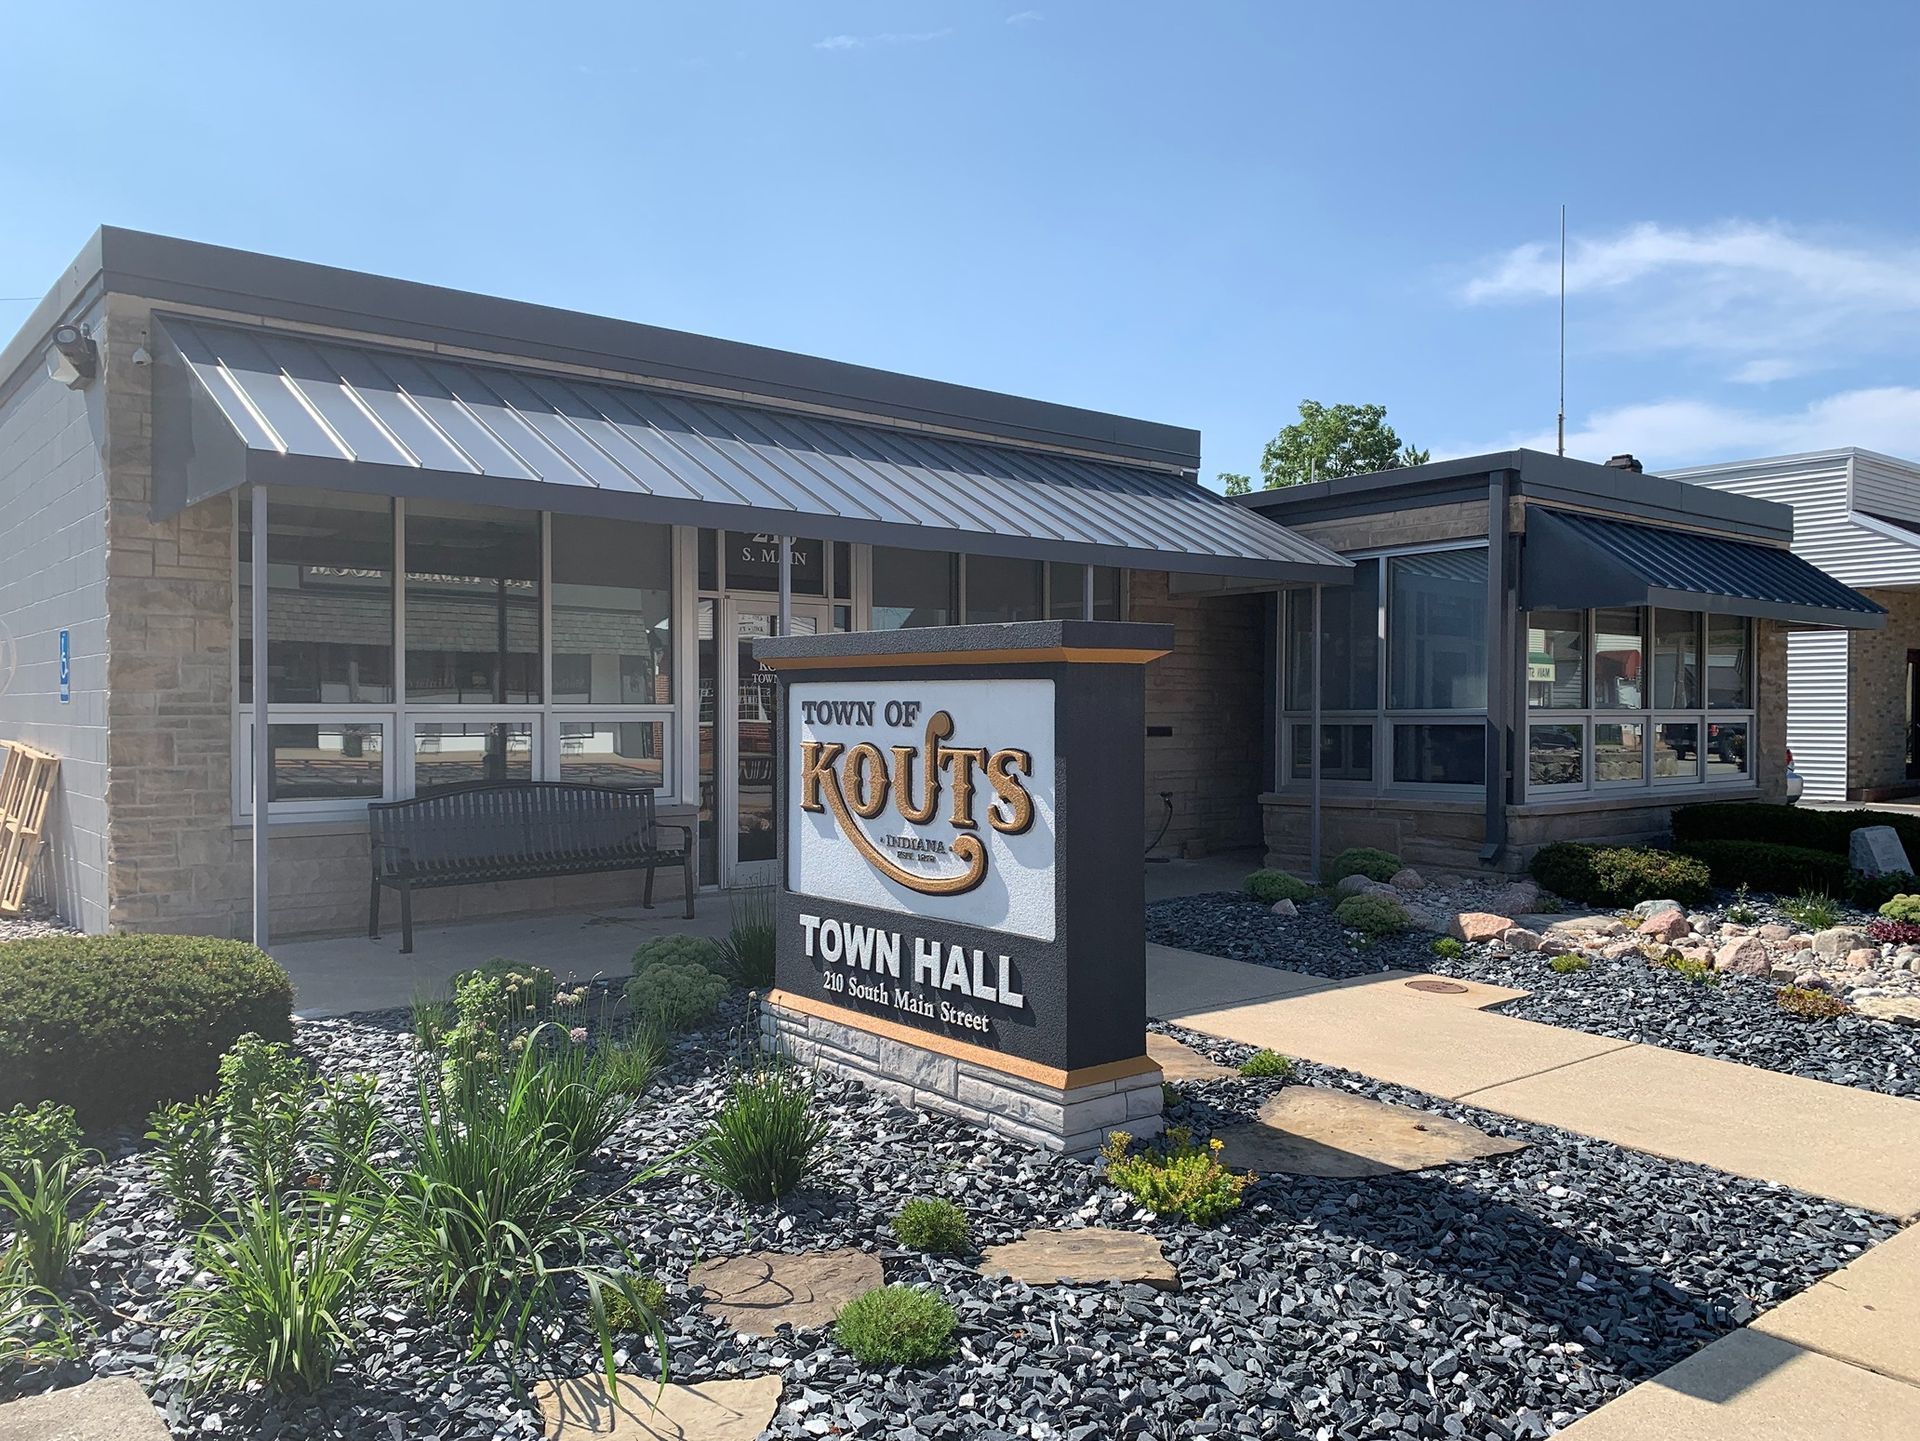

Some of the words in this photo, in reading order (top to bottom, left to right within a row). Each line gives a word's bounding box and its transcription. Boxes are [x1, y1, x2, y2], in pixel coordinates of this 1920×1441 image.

[742, 547, 755, 562] S.
[761, 549, 807, 566] MN
[801, 700, 875, 727] TOWN
[884, 700, 921, 728] OF
[800, 710, 1035, 836] KOUTS
[885, 834, 948, 855] INDIANA
[800, 914, 901, 979] TOWN
[914, 937, 1024, 1009] HALL
[823, 970, 845, 993] 210
[848, 976, 889, 1006] South
[893, 987, 935, 1019] Main
[940, 1000, 990, 1033] Street
